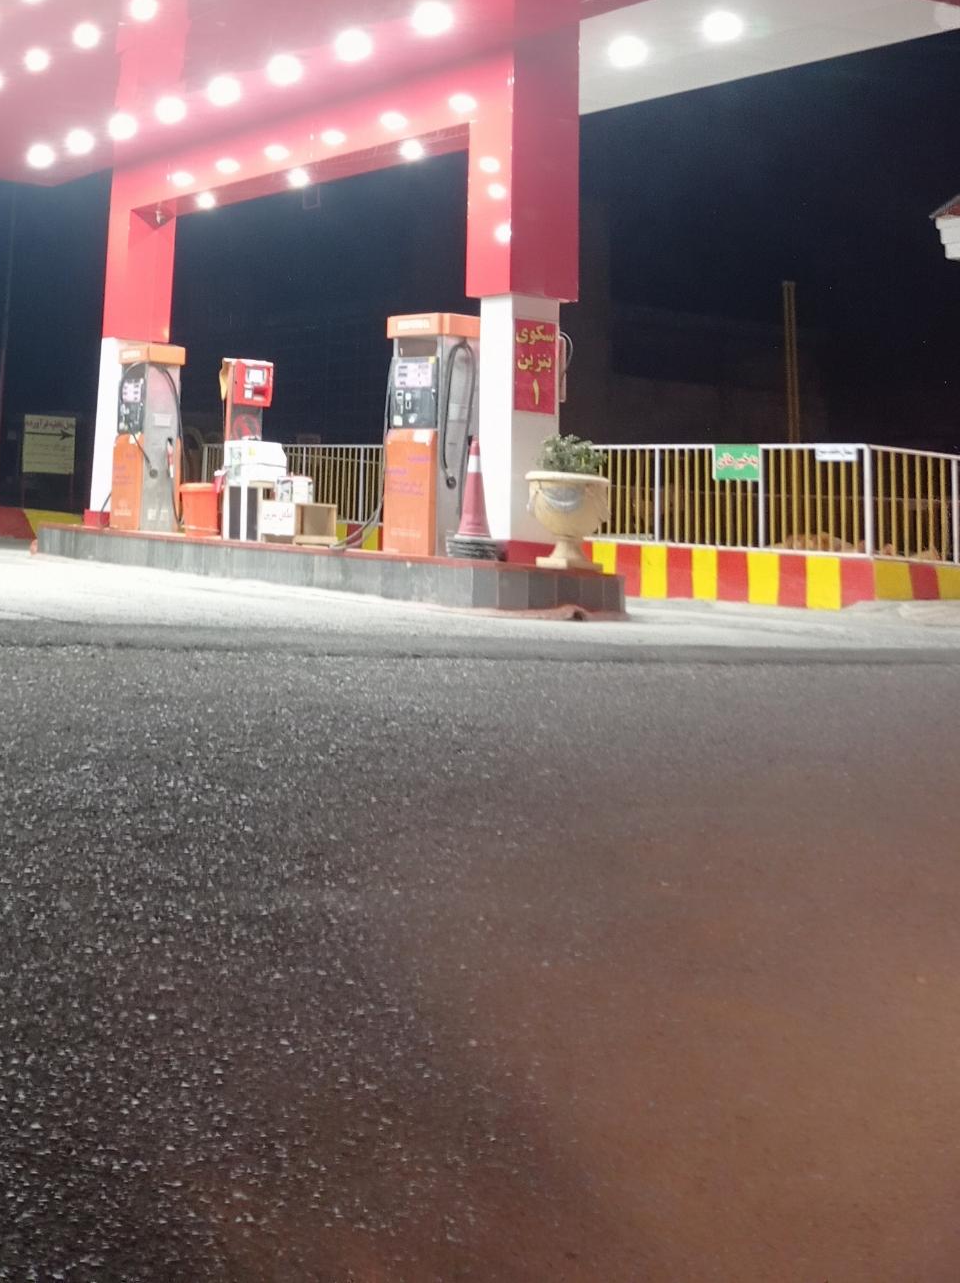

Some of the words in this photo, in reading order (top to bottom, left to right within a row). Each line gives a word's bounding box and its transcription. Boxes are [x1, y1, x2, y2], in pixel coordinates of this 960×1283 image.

[516, 324, 555, 345] سکوی
[517, 353, 552, 373] بنزین
[532, 379, 540, 405] ۱
